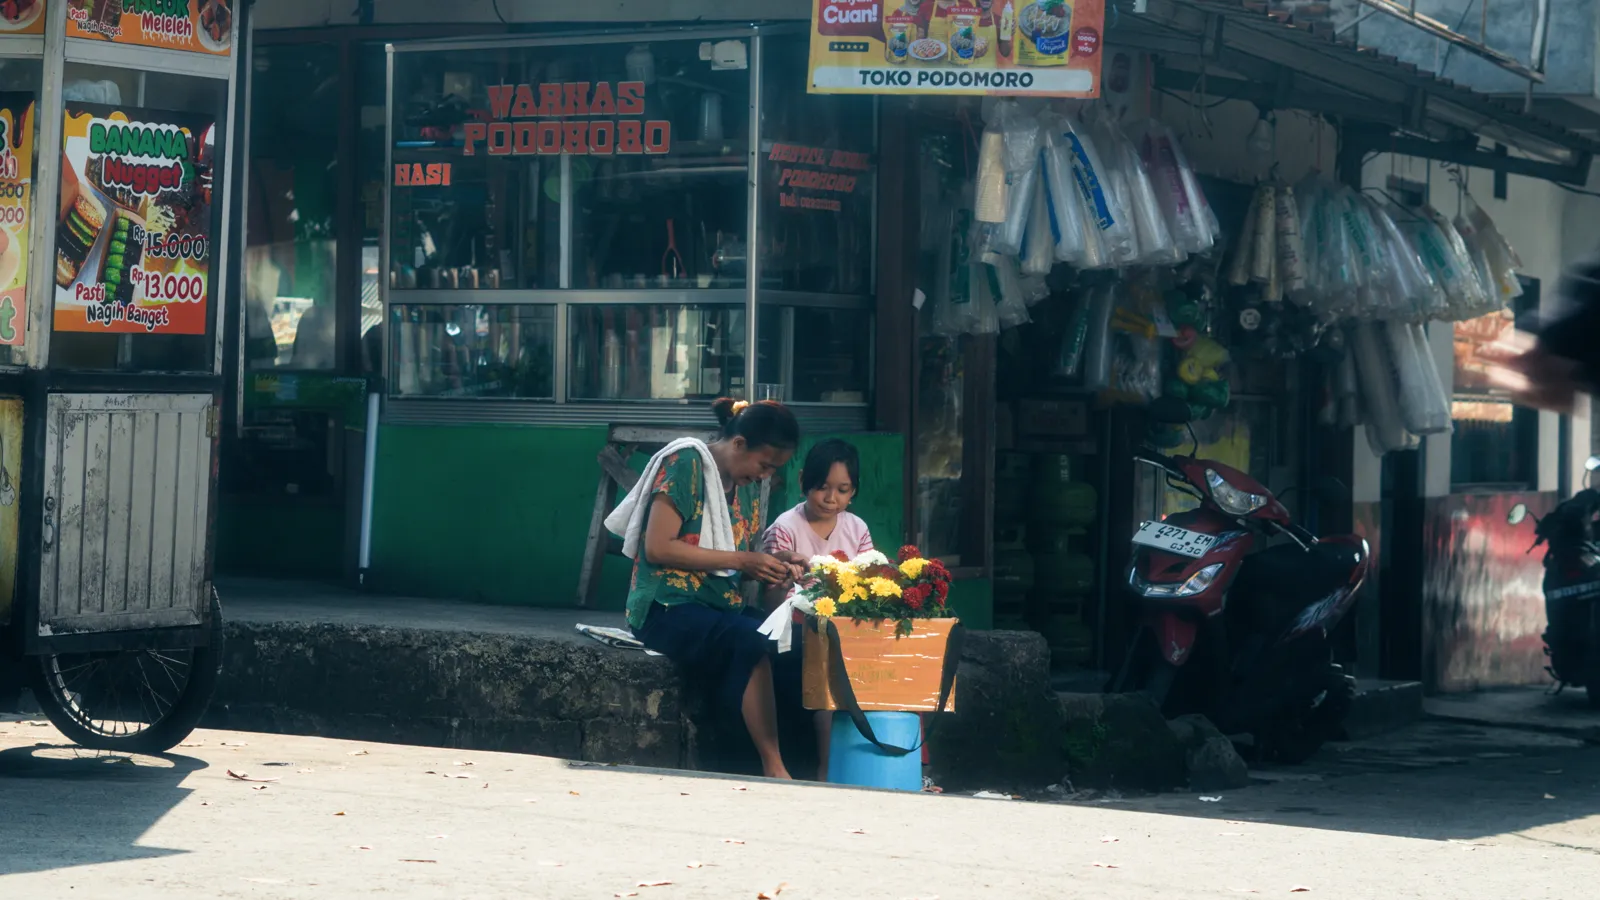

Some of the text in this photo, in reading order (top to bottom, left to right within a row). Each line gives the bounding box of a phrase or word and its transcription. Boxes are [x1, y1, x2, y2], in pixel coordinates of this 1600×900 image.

[71, 9, 87, 19] Pasti
[141, 12, 192, 36] Meleleh
[823, 4, 878, 24] Cuan!
[77, 20, 122, 37] Nagih Banget
[859, 70, 1034, 88] TOKO PODOMORO
[90, 122, 188, 161] BANANA
[103, 155, 183, 196] Nugget
[394, 163, 451, 186] NASI
[75, 282, 105, 301] Pasti
[87, 301, 169, 331] Nagih Banget
[1141, 521, 1213, 546] Z 4271 EM
